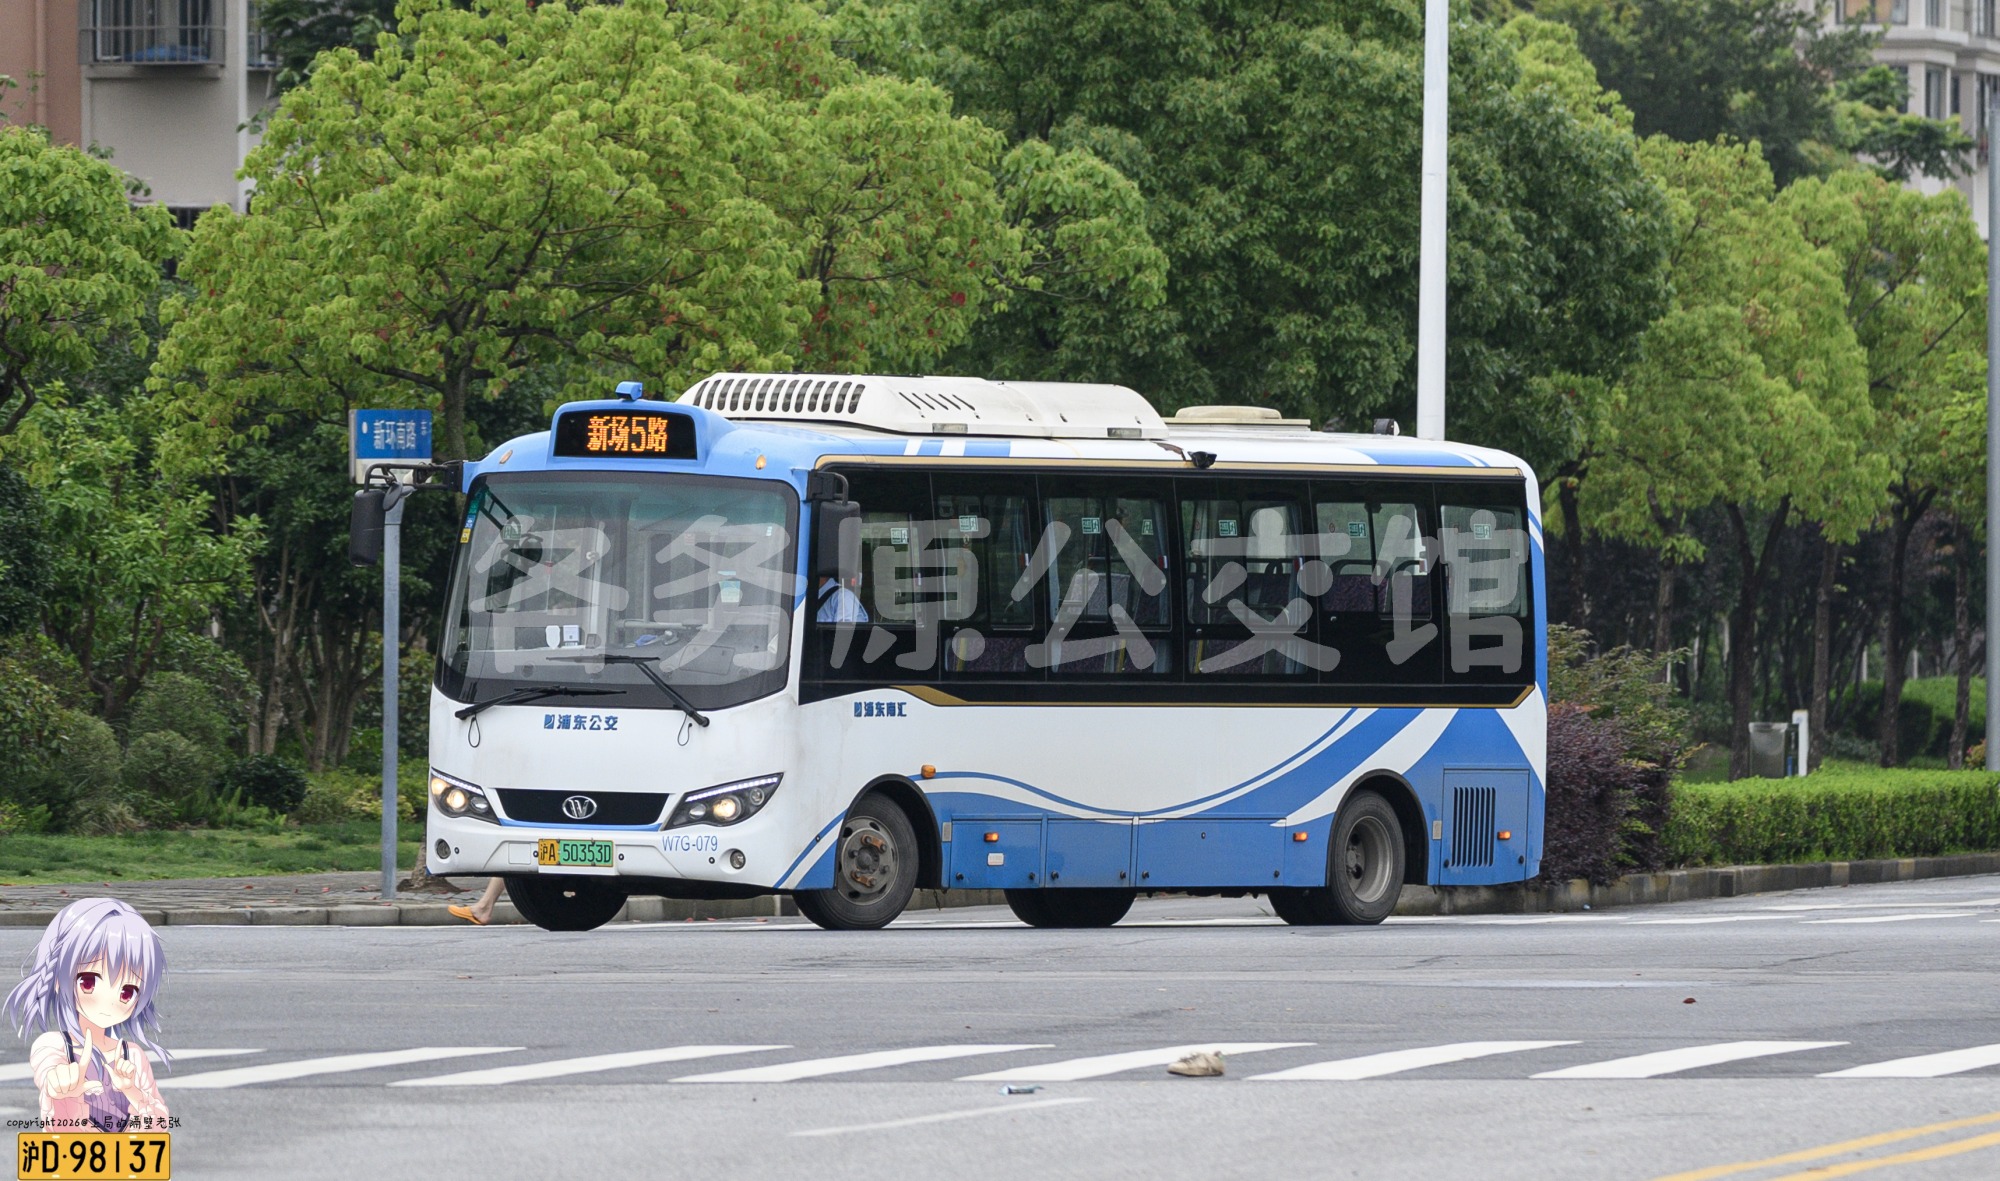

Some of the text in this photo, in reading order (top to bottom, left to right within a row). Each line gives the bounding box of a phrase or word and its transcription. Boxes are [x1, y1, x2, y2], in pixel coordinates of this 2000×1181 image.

[373, 419, 416, 450] 新环南路
[587, 416, 669, 452] 新场5路
[863, 701, 908, 718] 浦东南汇
[556, 714, 619, 731] 浦东公交
[662, 835, 718, 852] W7G-079
